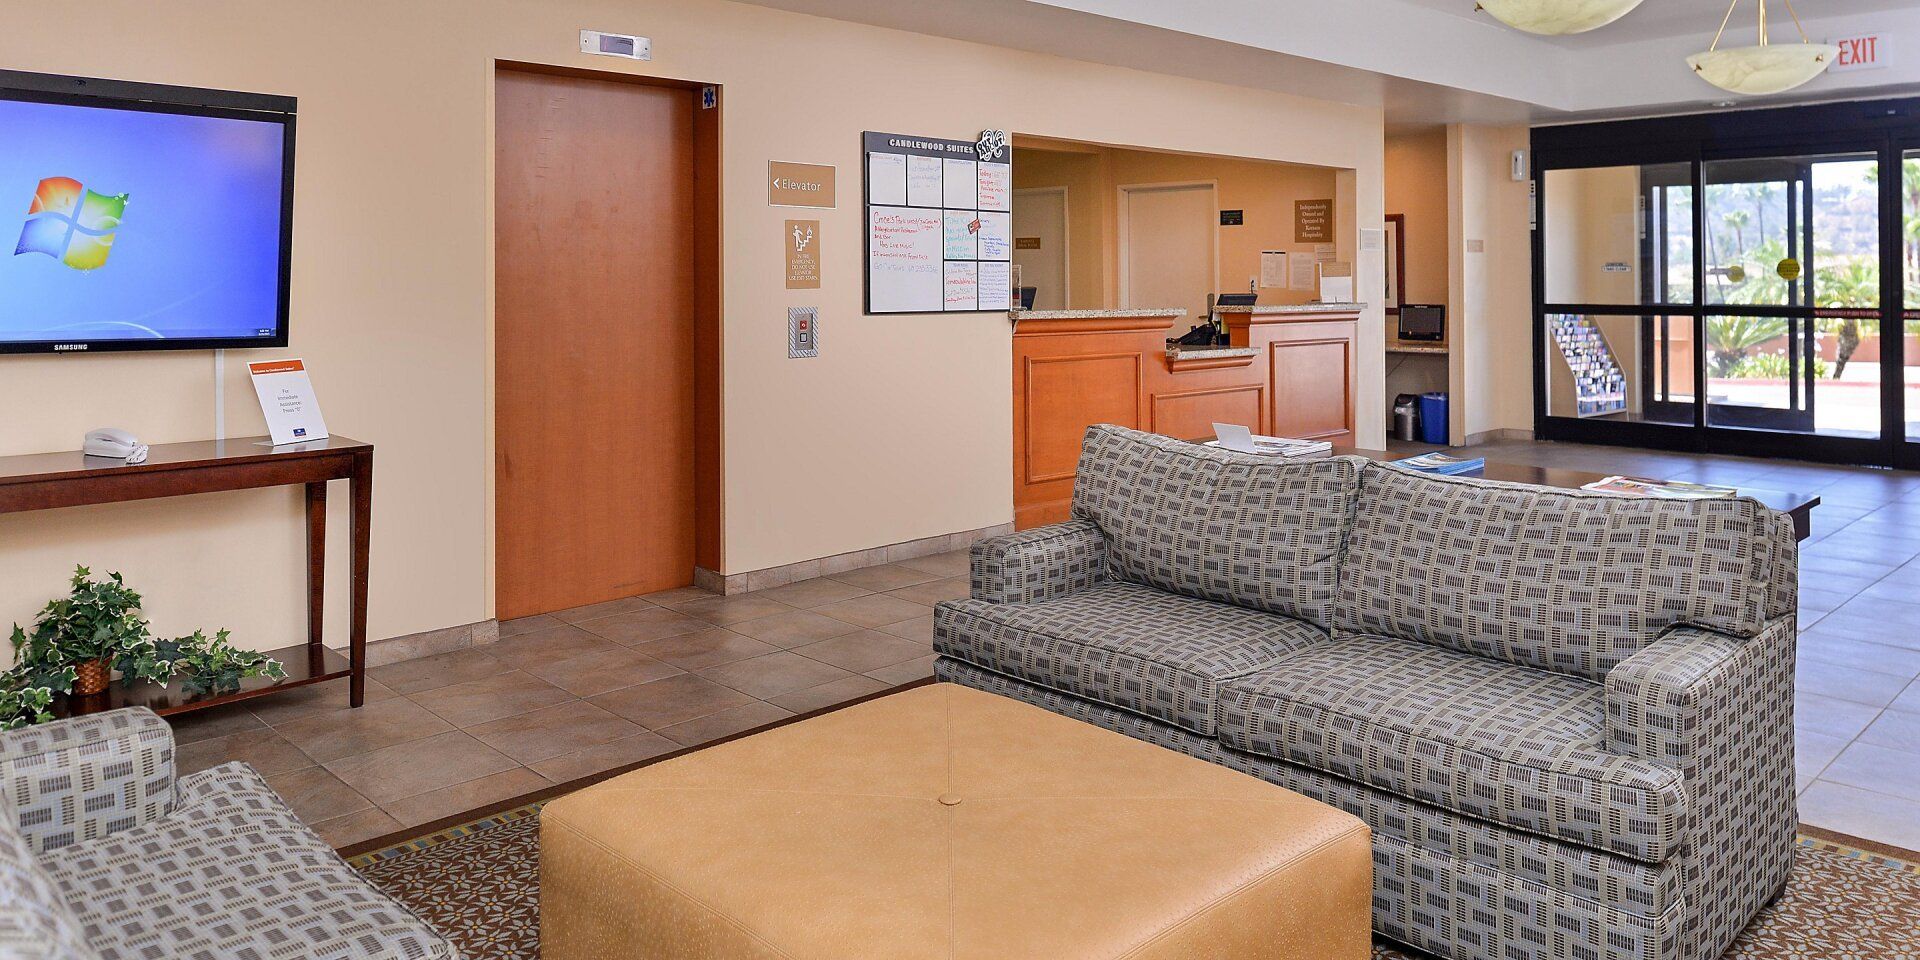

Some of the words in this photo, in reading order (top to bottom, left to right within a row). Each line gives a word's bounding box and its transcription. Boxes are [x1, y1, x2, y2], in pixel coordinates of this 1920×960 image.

[1839, 37, 1877, 65] EXIT
[889, 138, 944, 151] CANDLEWOOD
[946, 144, 974, 154] SUITES
[782, 178, 821, 191] Elevator
